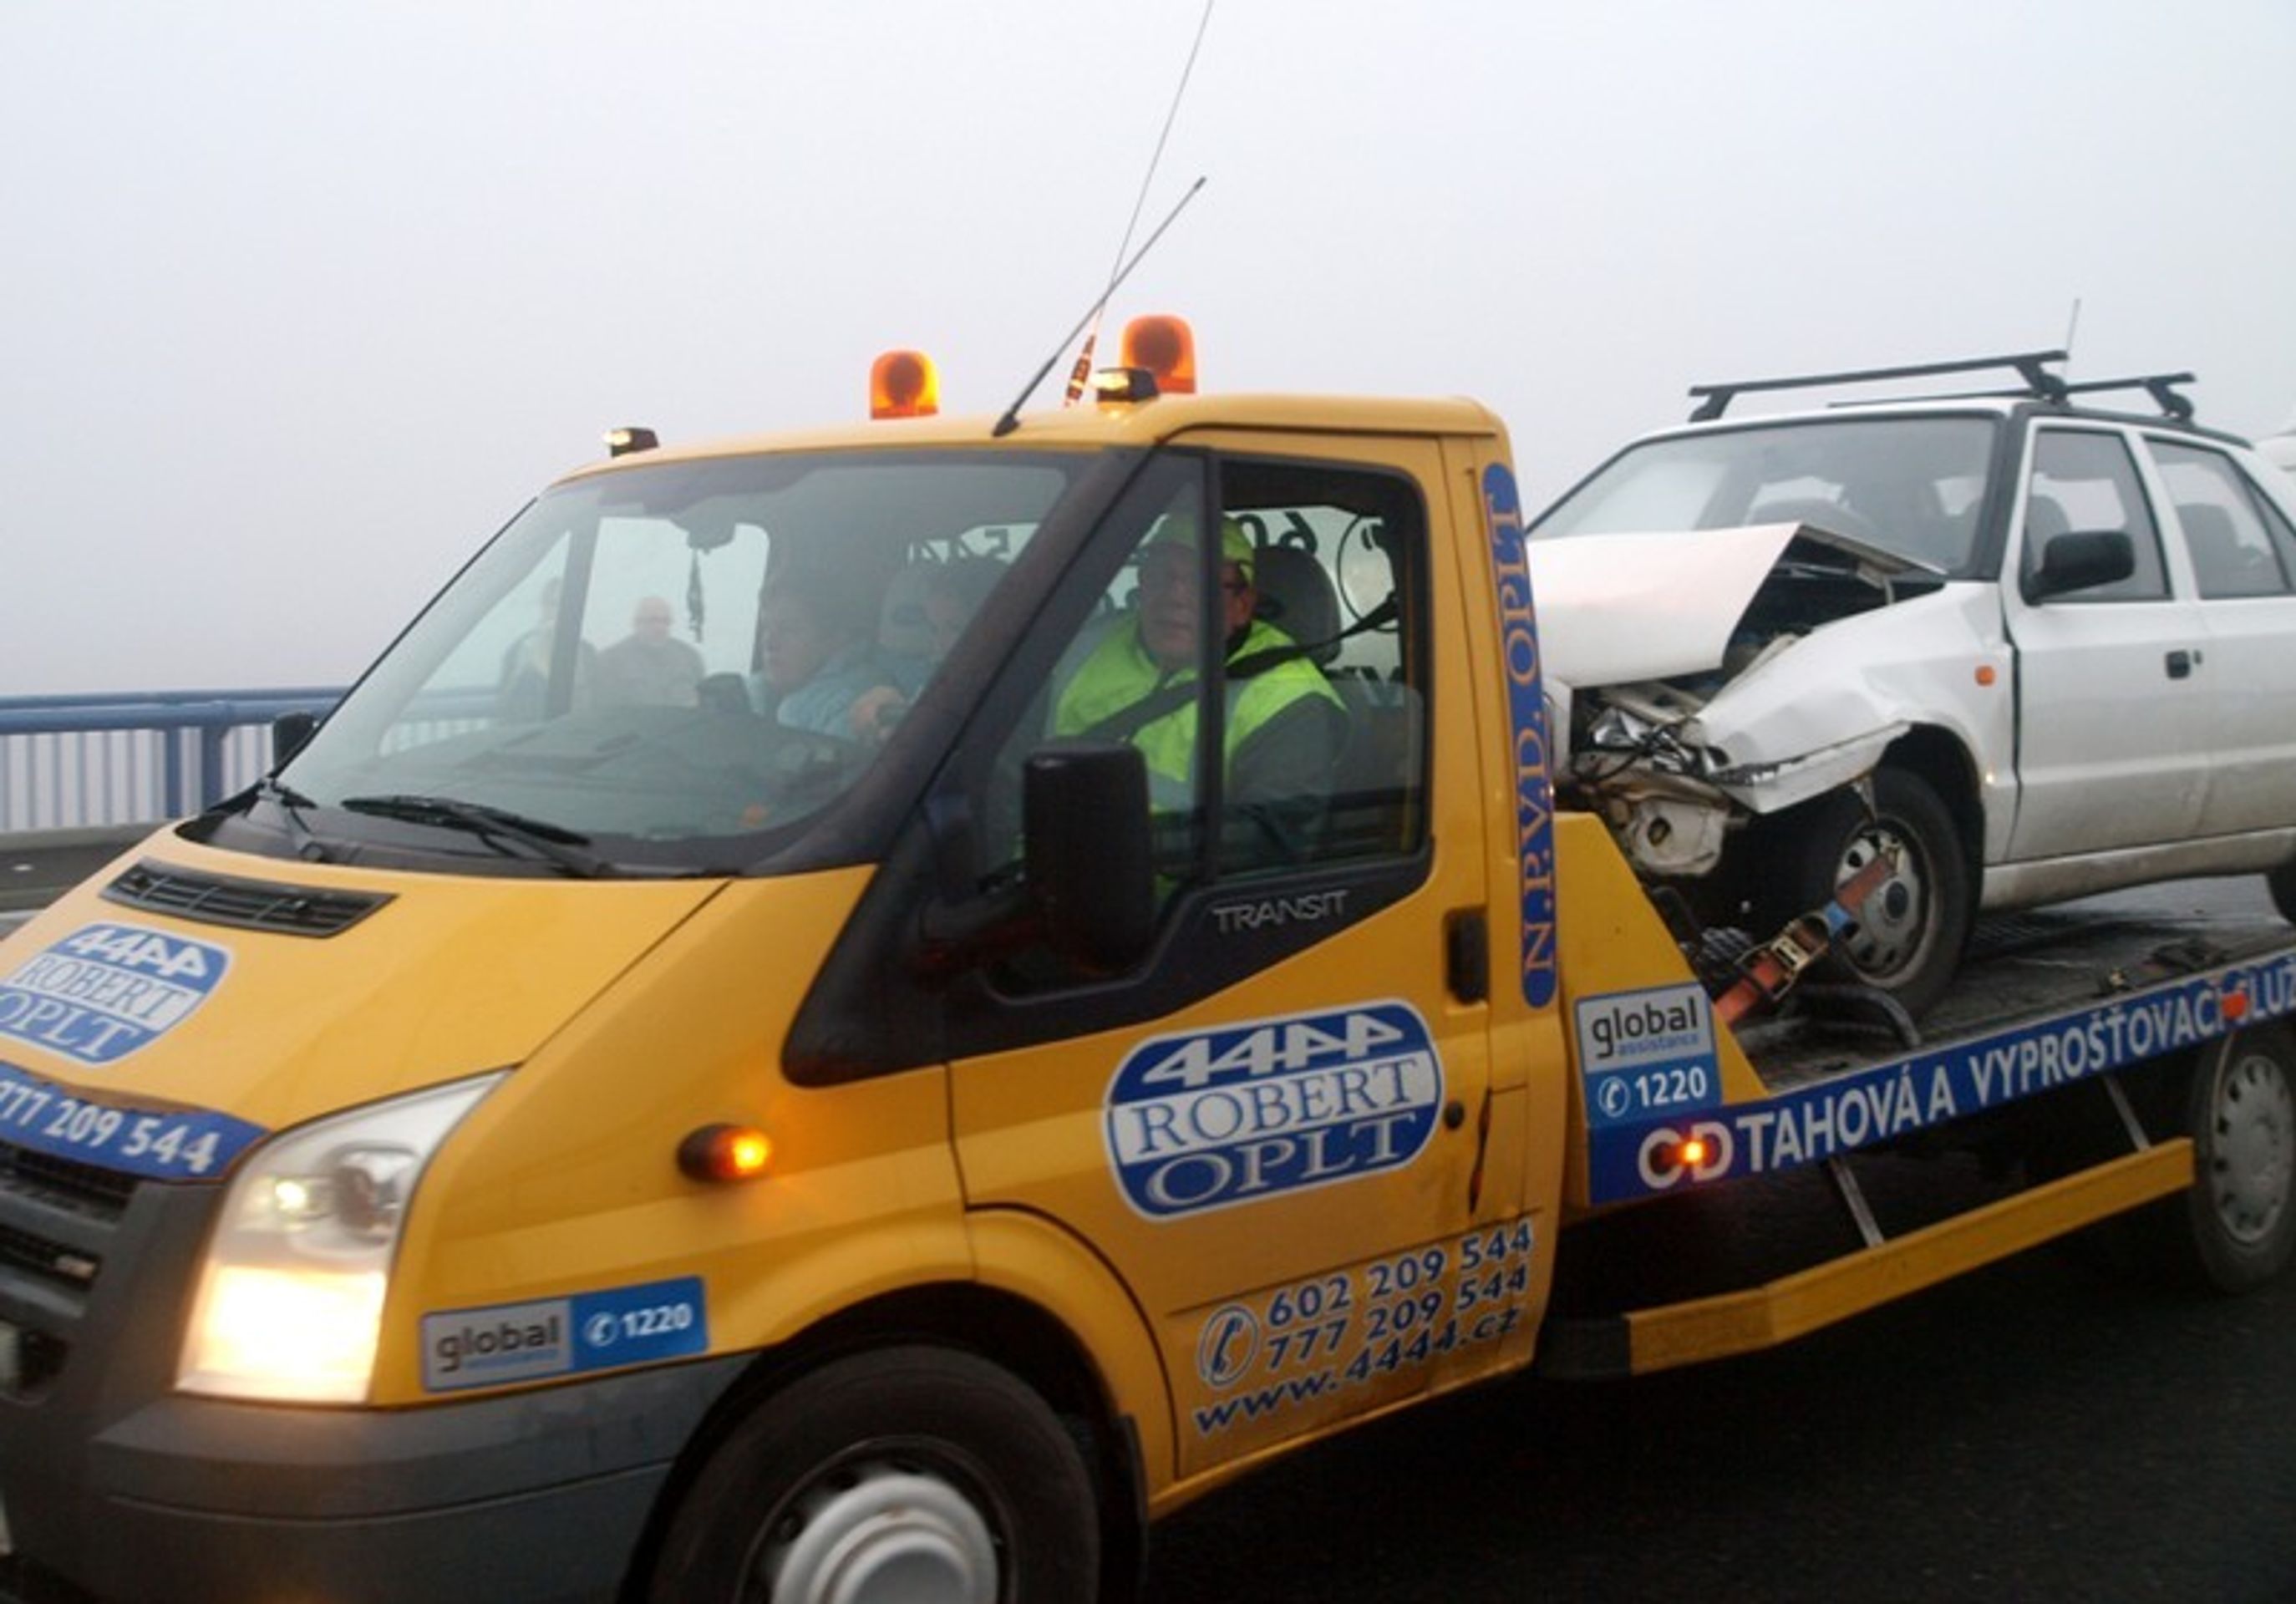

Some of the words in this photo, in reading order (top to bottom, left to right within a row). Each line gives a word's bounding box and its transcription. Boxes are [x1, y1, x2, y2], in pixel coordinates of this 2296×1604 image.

[1486, 492, 1537, 688] OPLT
[1213, 889, 1350, 933] TRANSIT
[13, 956, 189, 1020] ROBERT
[1592, 996, 1698, 1059] global
[1133, 1058, 1418, 1154] ROBERT
[1635, 1066, 1706, 1107] 1220
[1928, 1065, 1957, 1123] A
[44, 1099, 124, 1147] 209
[122, 1117, 221, 1173] 544
[1145, 1112, 1415, 1206] OPLT
[1267, 1277, 1350, 1327] 602
[1369, 1250, 1445, 1298] 209
[1460, 1222, 1532, 1270] 544
[435, 1315, 560, 1373] global
[622, 1302, 694, 1337] 1220
[1267, 1319, 1348, 1368] 777
[1367, 1292, 1441, 1339] 209
[1457, 1265, 1527, 1310] 544
[1195, 1307, 1519, 1433] www.4444.cz
